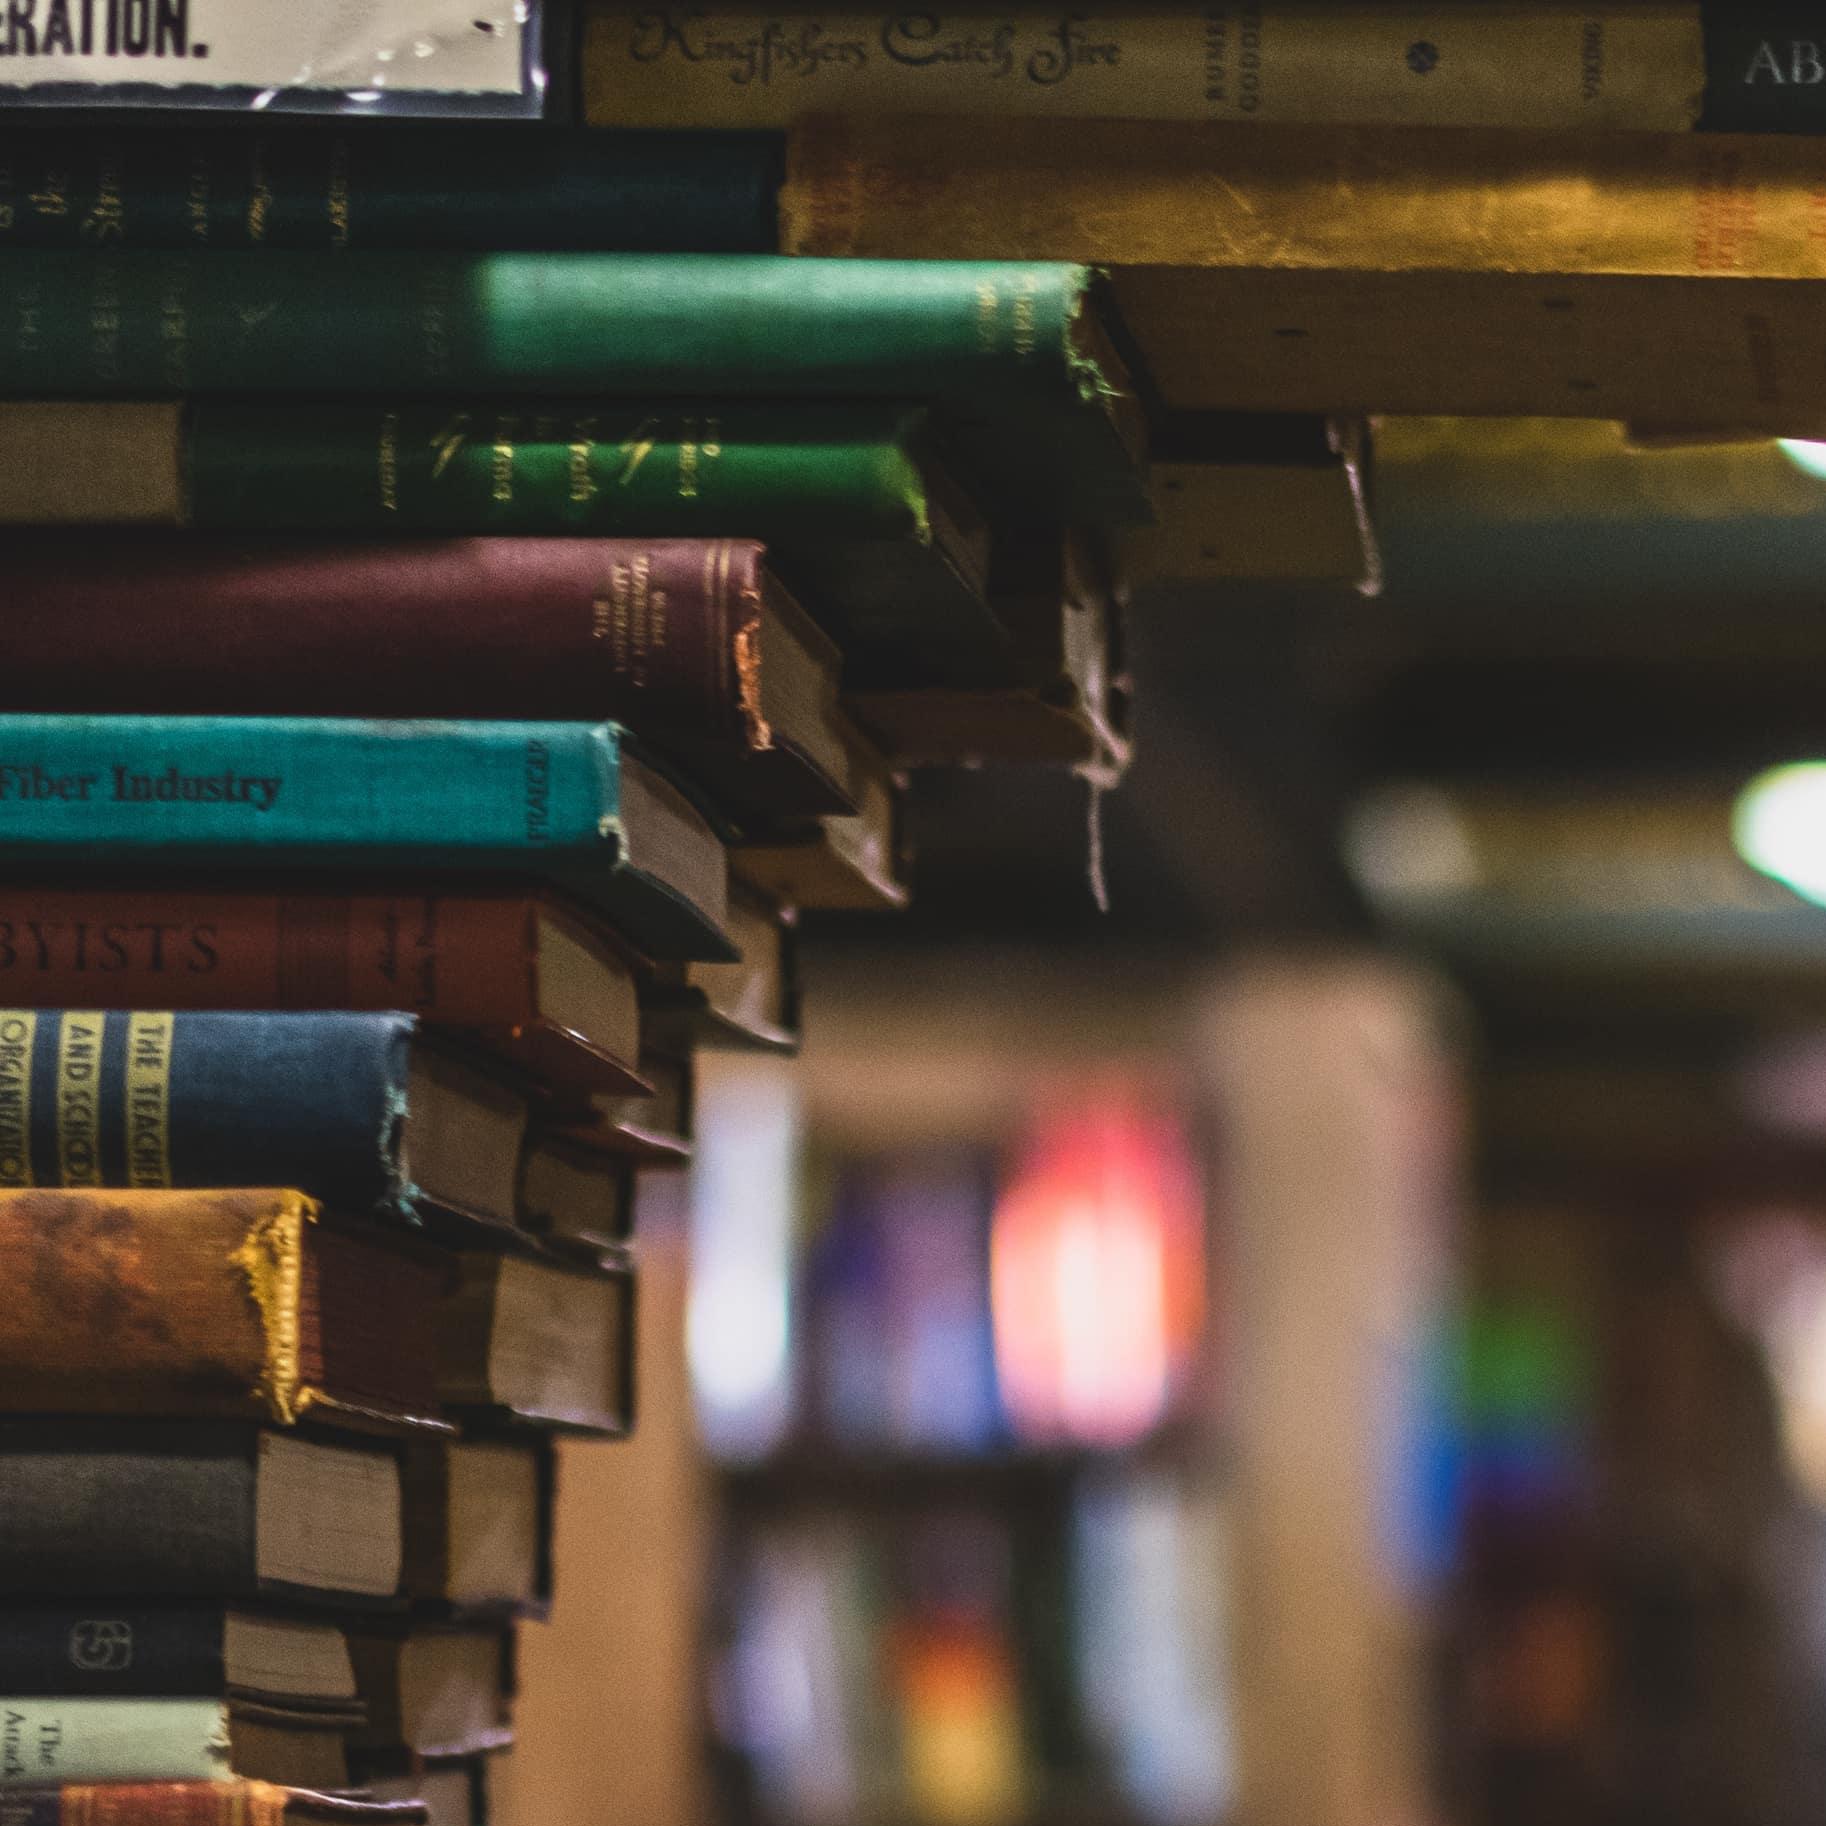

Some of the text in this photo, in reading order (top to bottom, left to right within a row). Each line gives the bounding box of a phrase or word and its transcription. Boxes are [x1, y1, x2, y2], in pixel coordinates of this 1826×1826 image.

[113, 764, 283, 812] Industry
[66, 1025, 96, 1081] AND
[135, 1025, 165, 1069] THE
[39, 1719, 63, 1767] The
